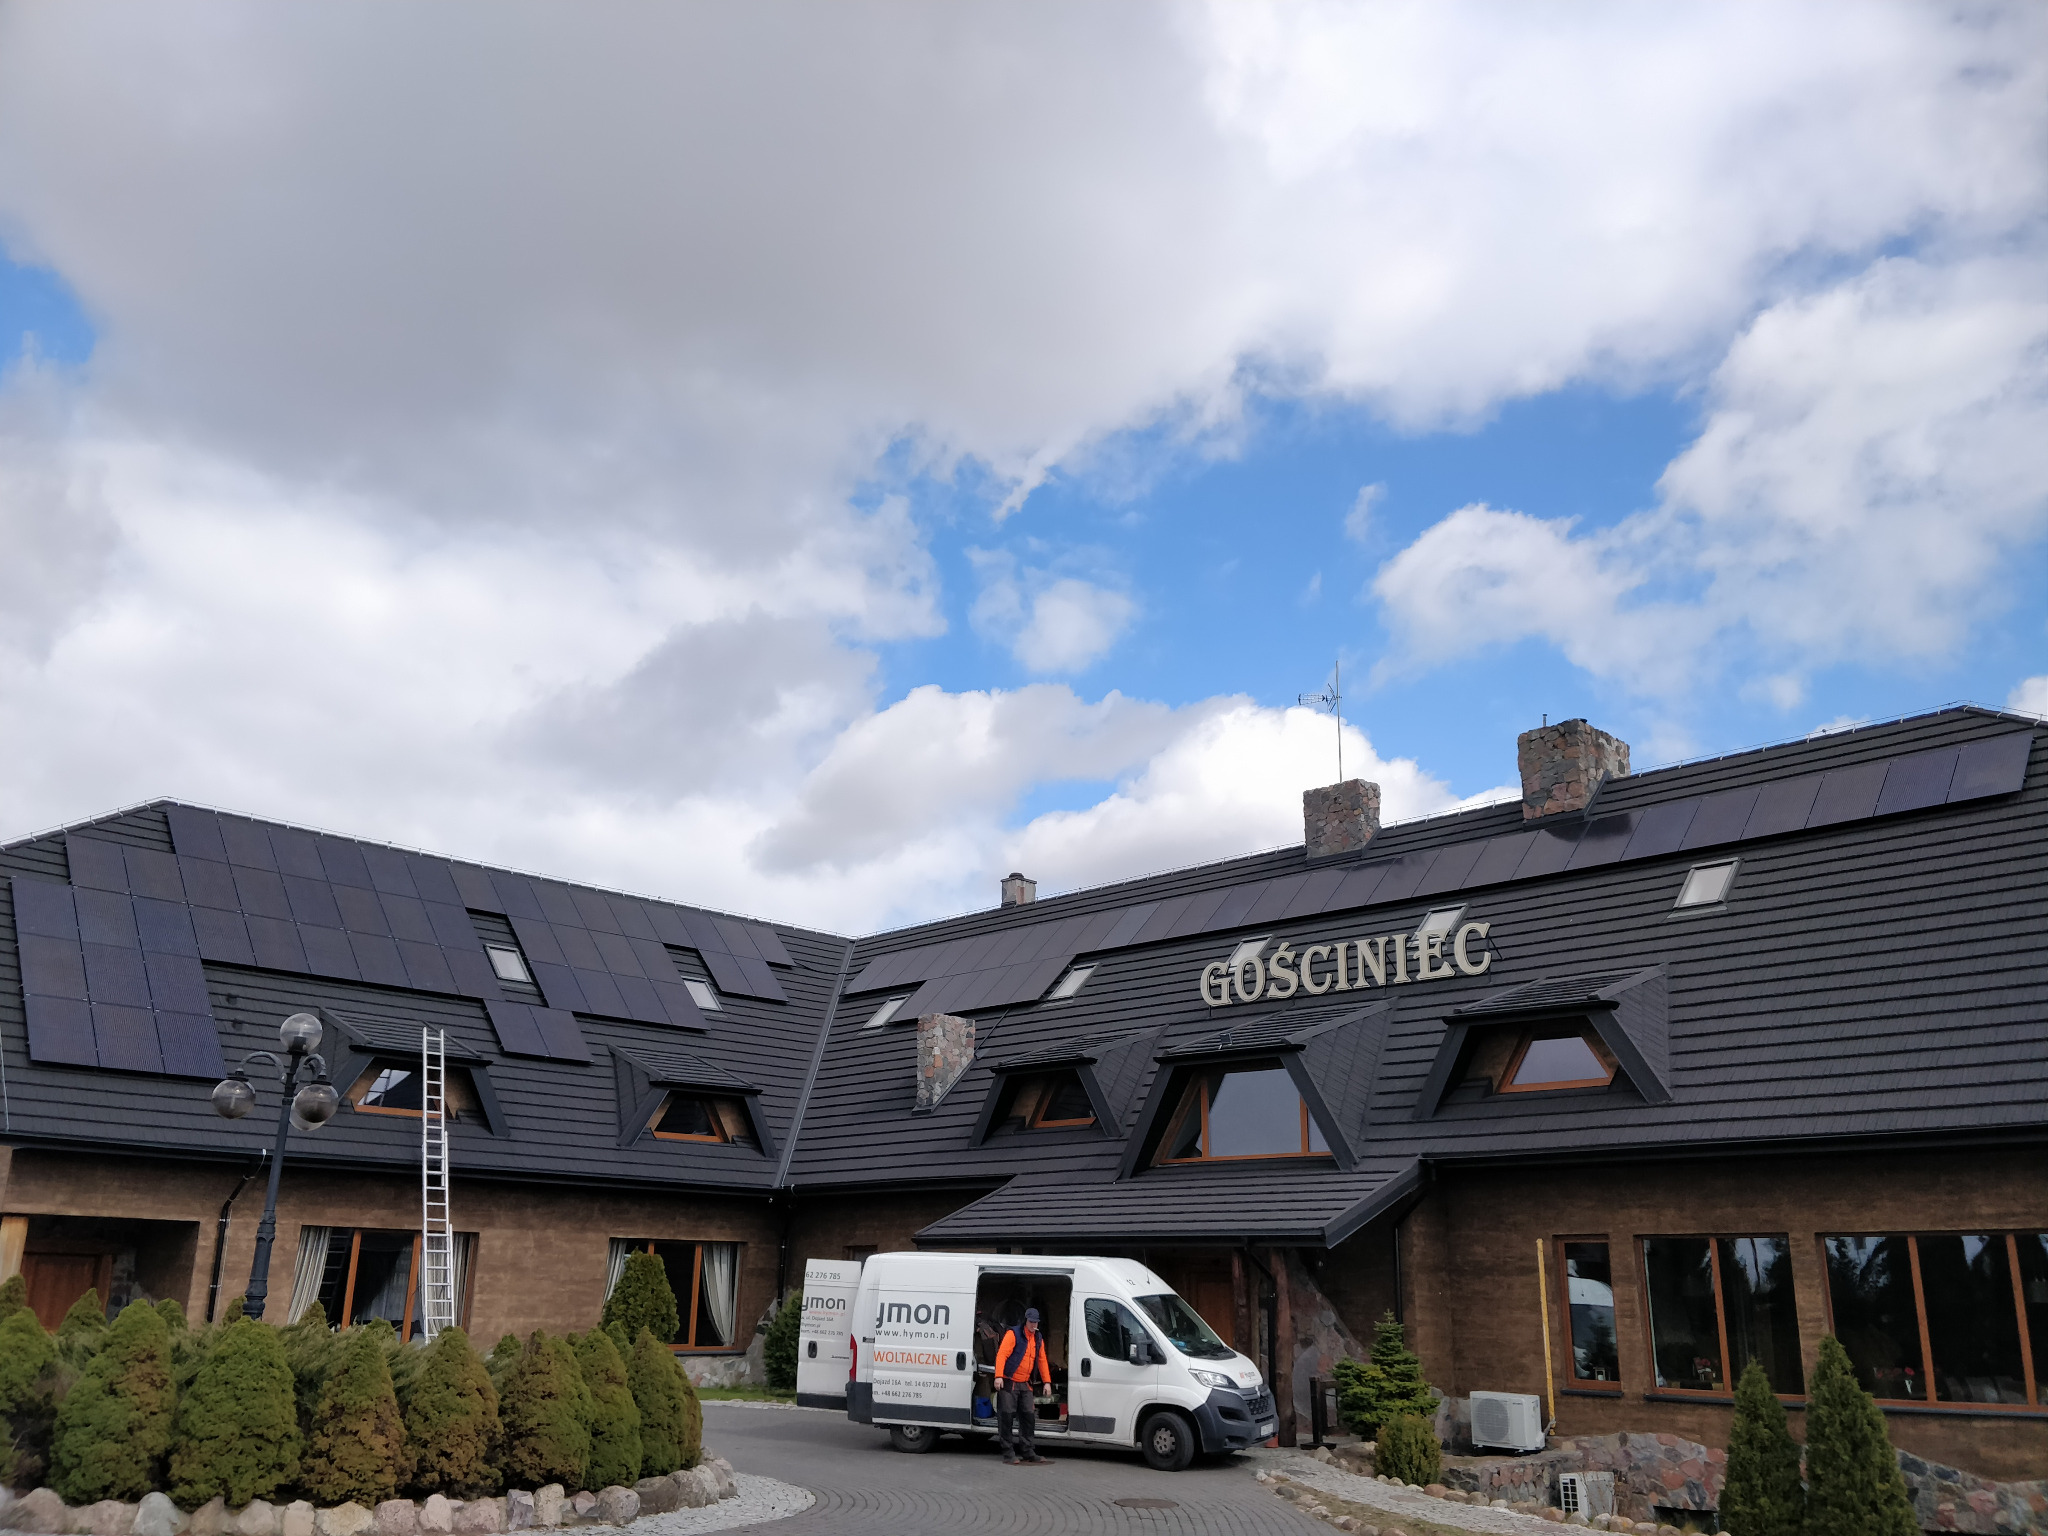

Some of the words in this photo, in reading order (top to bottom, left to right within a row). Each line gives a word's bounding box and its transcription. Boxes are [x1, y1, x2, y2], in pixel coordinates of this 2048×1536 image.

[1200, 922, 1491, 1007] GOŚCINIEC
[815, 1271, 828, 1280] 276
[829, 1272, 841, 1280] 785
[875, 1328, 949, 1341] www.hymon.pl
[874, 1350, 948, 1366] WOLTAICZNE
[892, 1390, 901, 1398] 662
